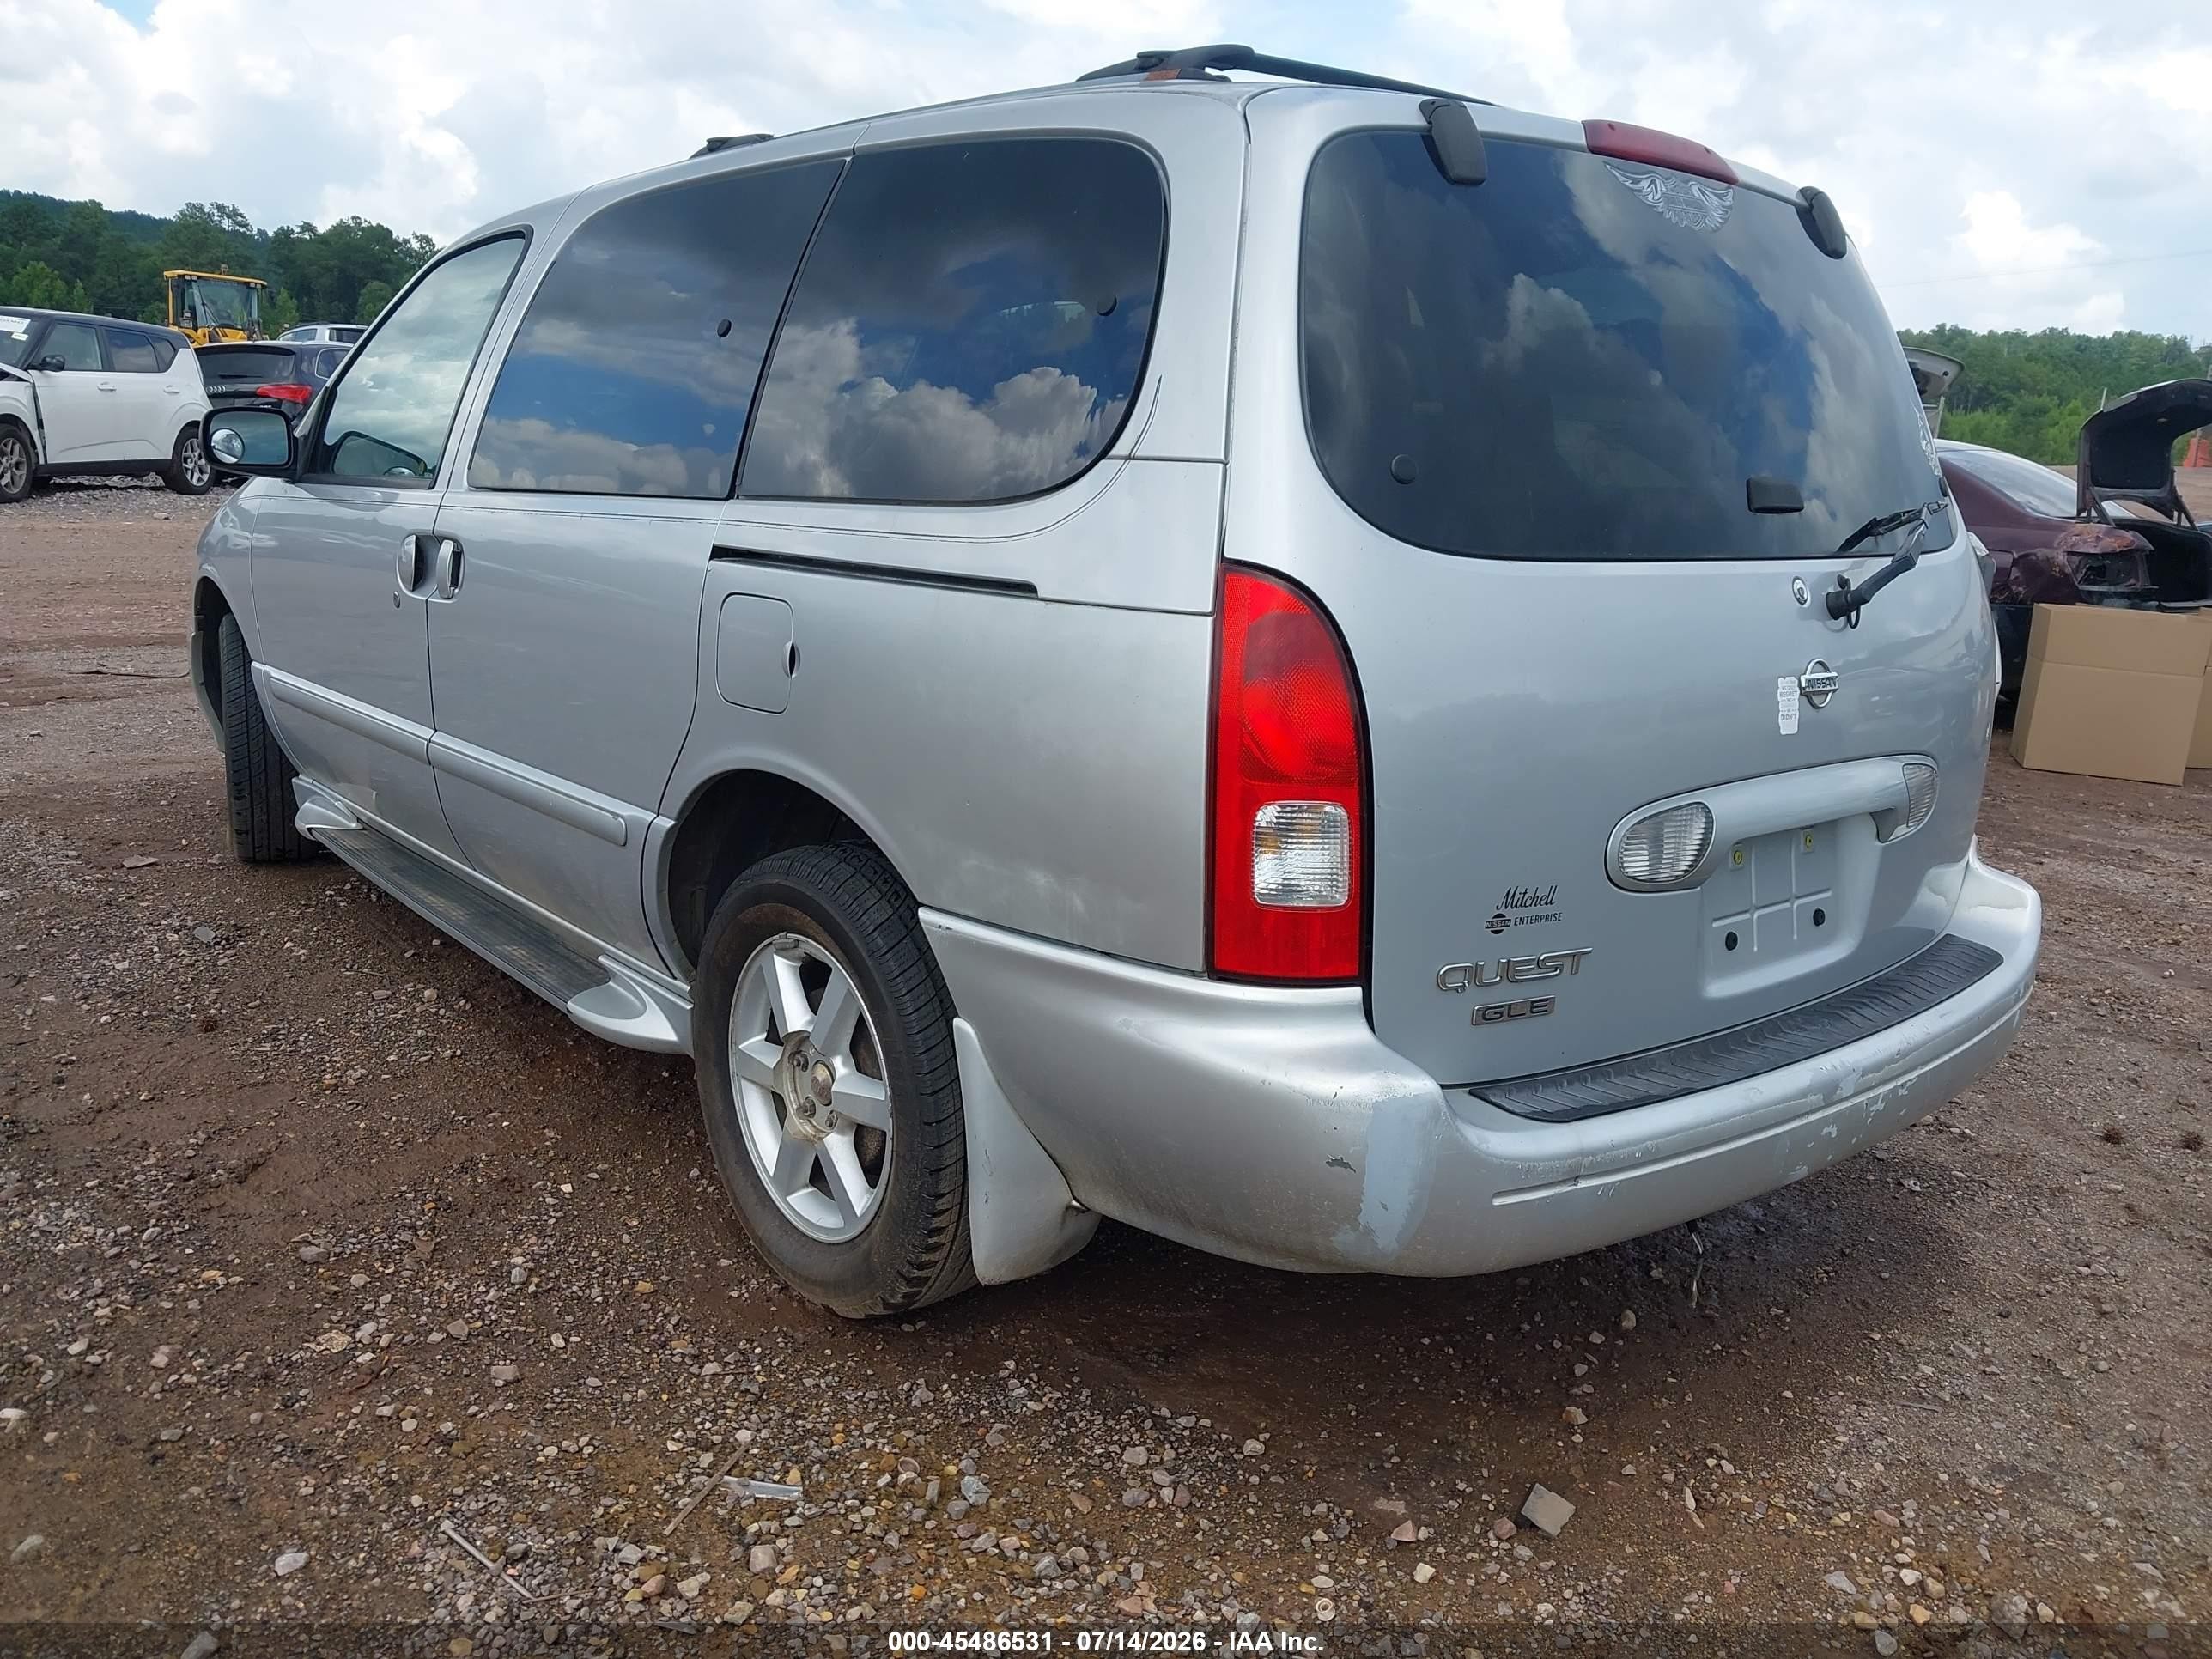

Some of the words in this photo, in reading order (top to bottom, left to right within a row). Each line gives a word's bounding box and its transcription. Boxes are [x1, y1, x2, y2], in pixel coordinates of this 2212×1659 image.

[1807, 676, 1837, 690] NISSAN
[1496, 885, 1558, 910] Mitchell
[1486, 919, 1511, 928] NISSAN
[1514, 912, 1563, 927] ENTERPRISE
[1437, 947, 1593, 993] QUEST
[1482, 998, 1550, 1021] GLE
